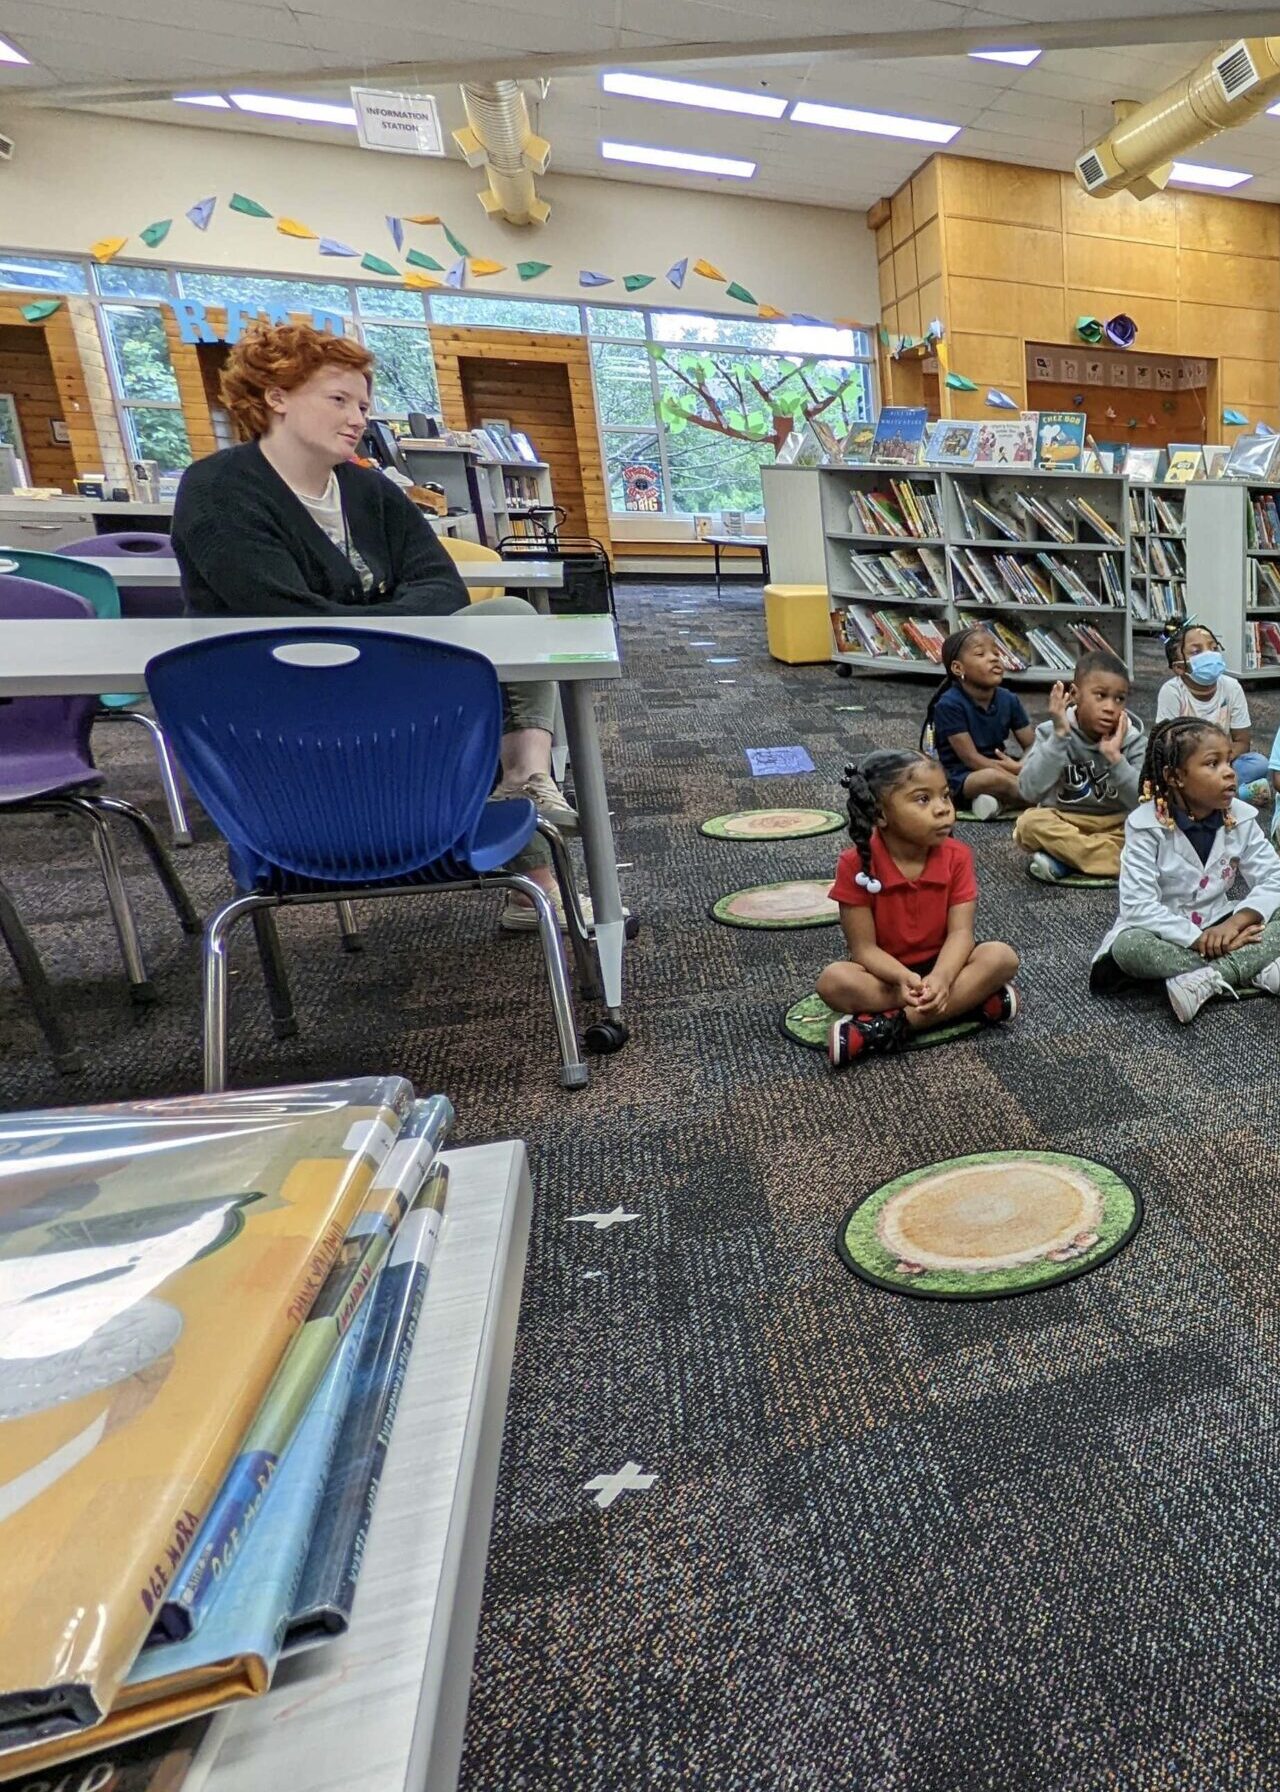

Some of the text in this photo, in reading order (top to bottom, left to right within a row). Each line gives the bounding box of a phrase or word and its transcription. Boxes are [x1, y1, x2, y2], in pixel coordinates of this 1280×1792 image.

[366, 107, 429, 121] INFORMATION
[381, 121, 419, 132] STATION
[1042, 415, 1062, 424] CHEZ
[286, 1277, 318, 1327] THANK
[211, 1459, 278, 1582] OGE MORA
[140, 1564, 169, 1615] OGE
[165, 1509, 200, 1568] MORA
